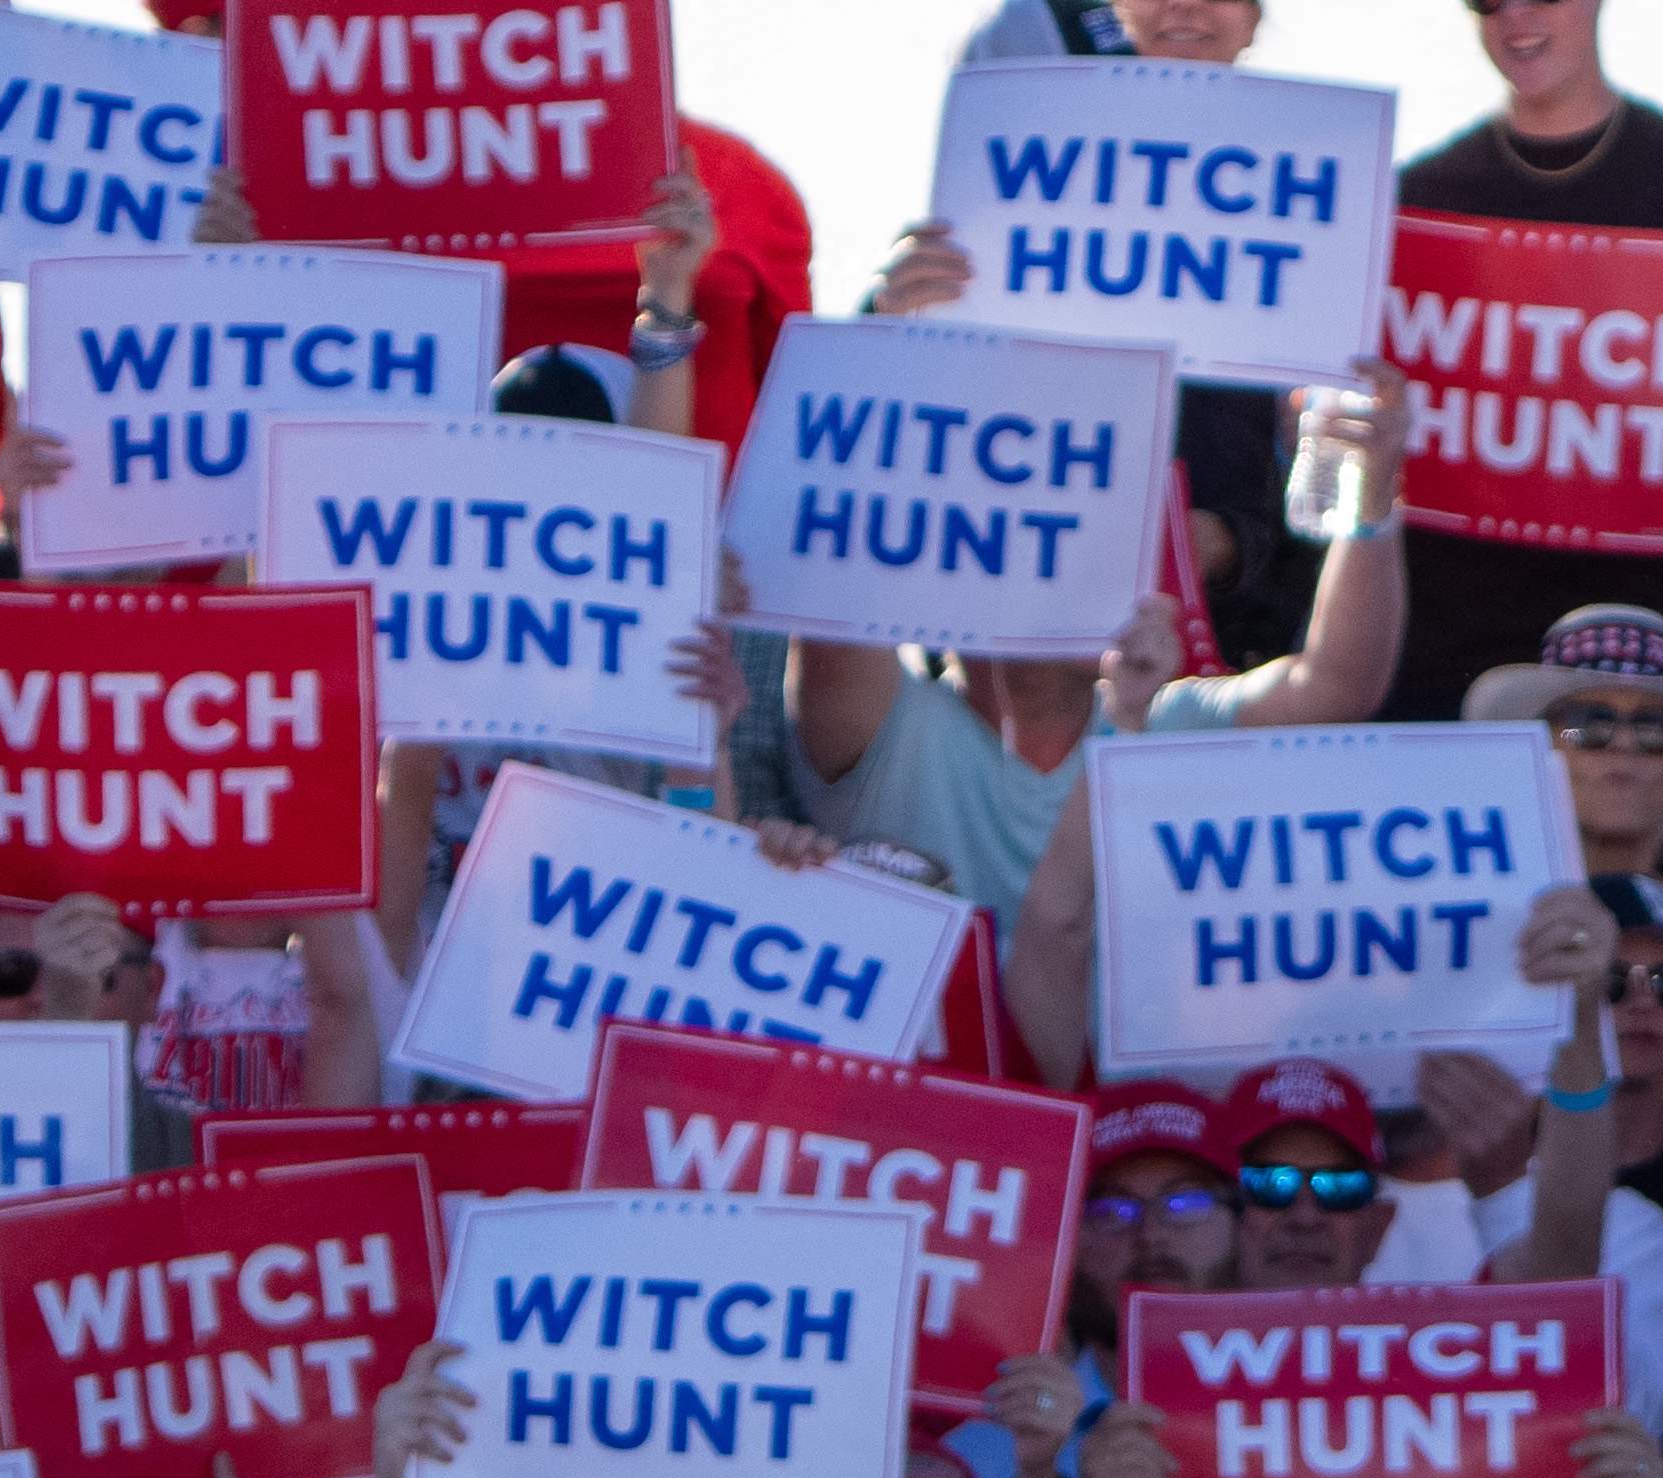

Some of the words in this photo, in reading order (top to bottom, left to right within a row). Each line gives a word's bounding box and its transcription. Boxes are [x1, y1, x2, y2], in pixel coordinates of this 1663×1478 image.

[270, 12, 631, 95] WITCH
[303, 100, 606, 190] HUNT
[987, 137, 1341, 223] WITCH
[1006, 227, 1303, 308] HUNT
[80, 325, 437, 397] WITCH
[110, 412, 249, 487] HU
[798, 395, 1113, 490] WITCH
[317, 497, 669, 588] WITCH
[793, 487, 1080, 580] HUNT
[374, 594, 641, 675] HUNT
[1153, 805, 1514, 893] WITCH
[527, 855, 885, 1022] WITCH
[1194, 902, 1491, 988] HUNT
[642, 1107, 1028, 1247] WITCH
[35, 1234, 397, 1358] WITCH
[494, 1275, 853, 1362] WITCH
[75, 1338, 376, 1456] HUNT
[1180, 1321, 1566, 1386] WITCH
[507, 1371, 814, 1460] HUNT
